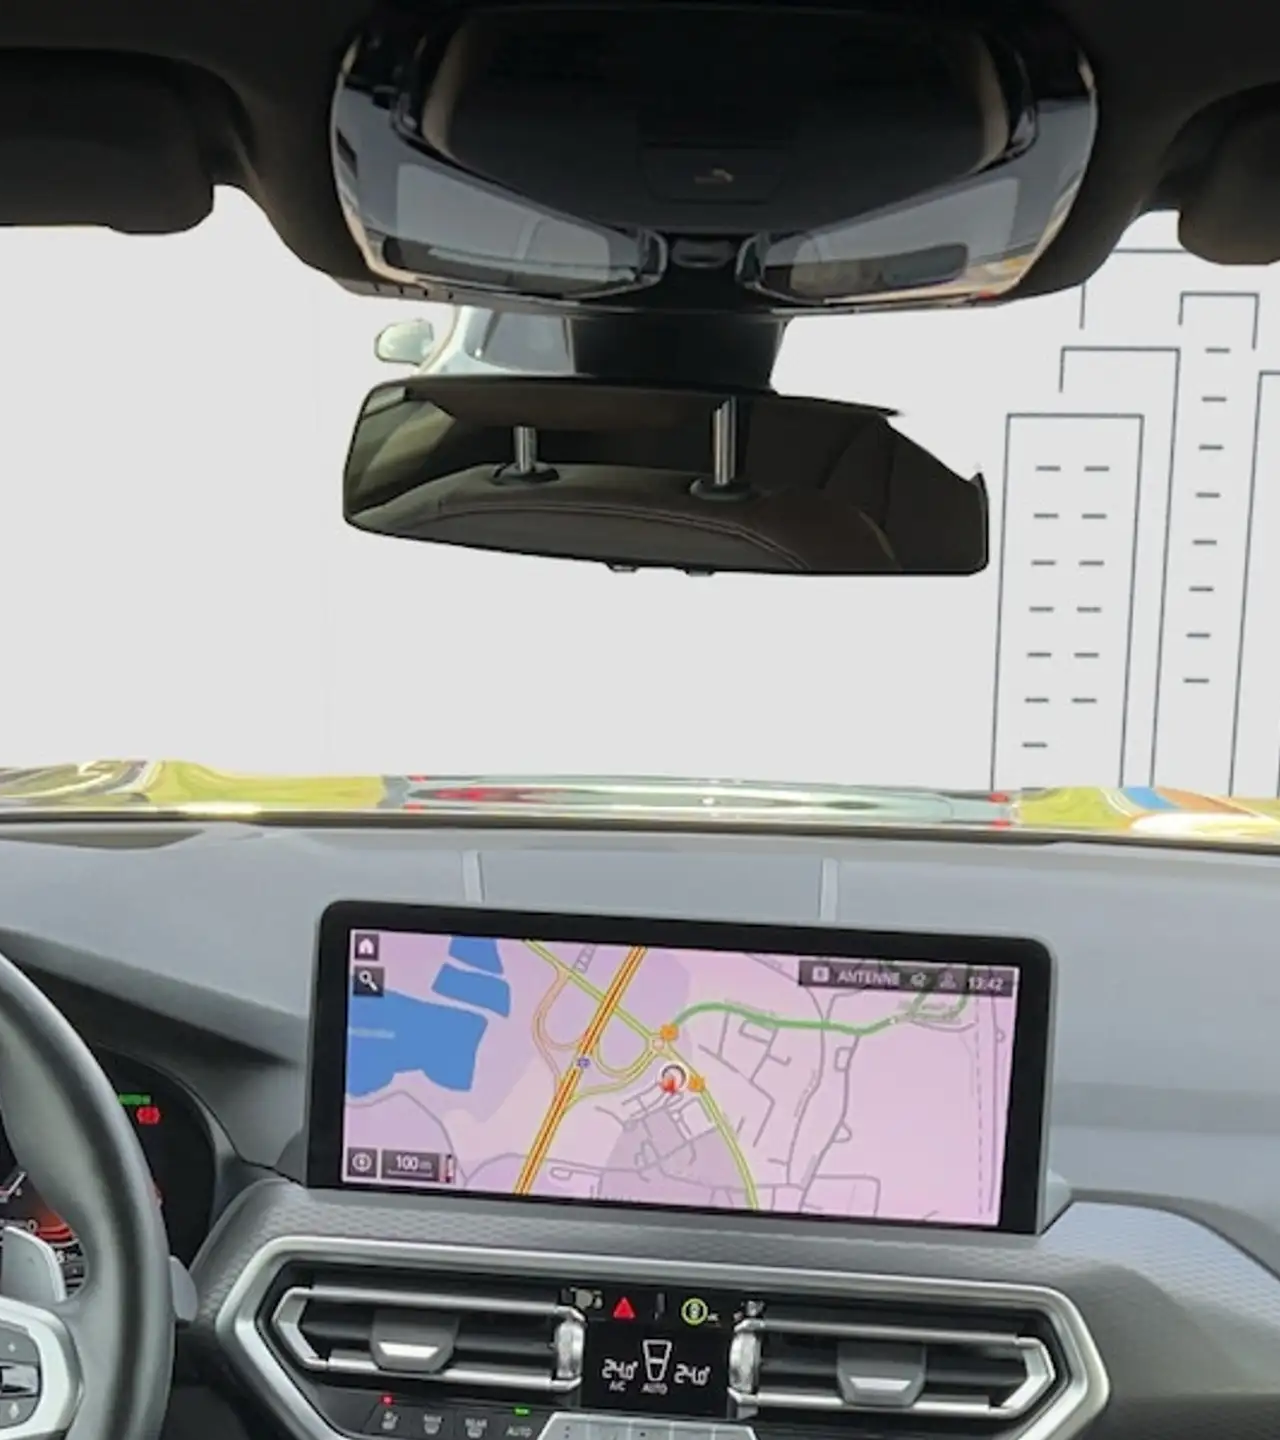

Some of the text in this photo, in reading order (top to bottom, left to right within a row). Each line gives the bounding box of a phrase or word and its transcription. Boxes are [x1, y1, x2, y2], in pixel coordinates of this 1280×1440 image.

[836, 970, 901, 986] ANTENNE
[395, 1154, 419, 1171] 100
[506, 1426, 533, 1439] AUTO
